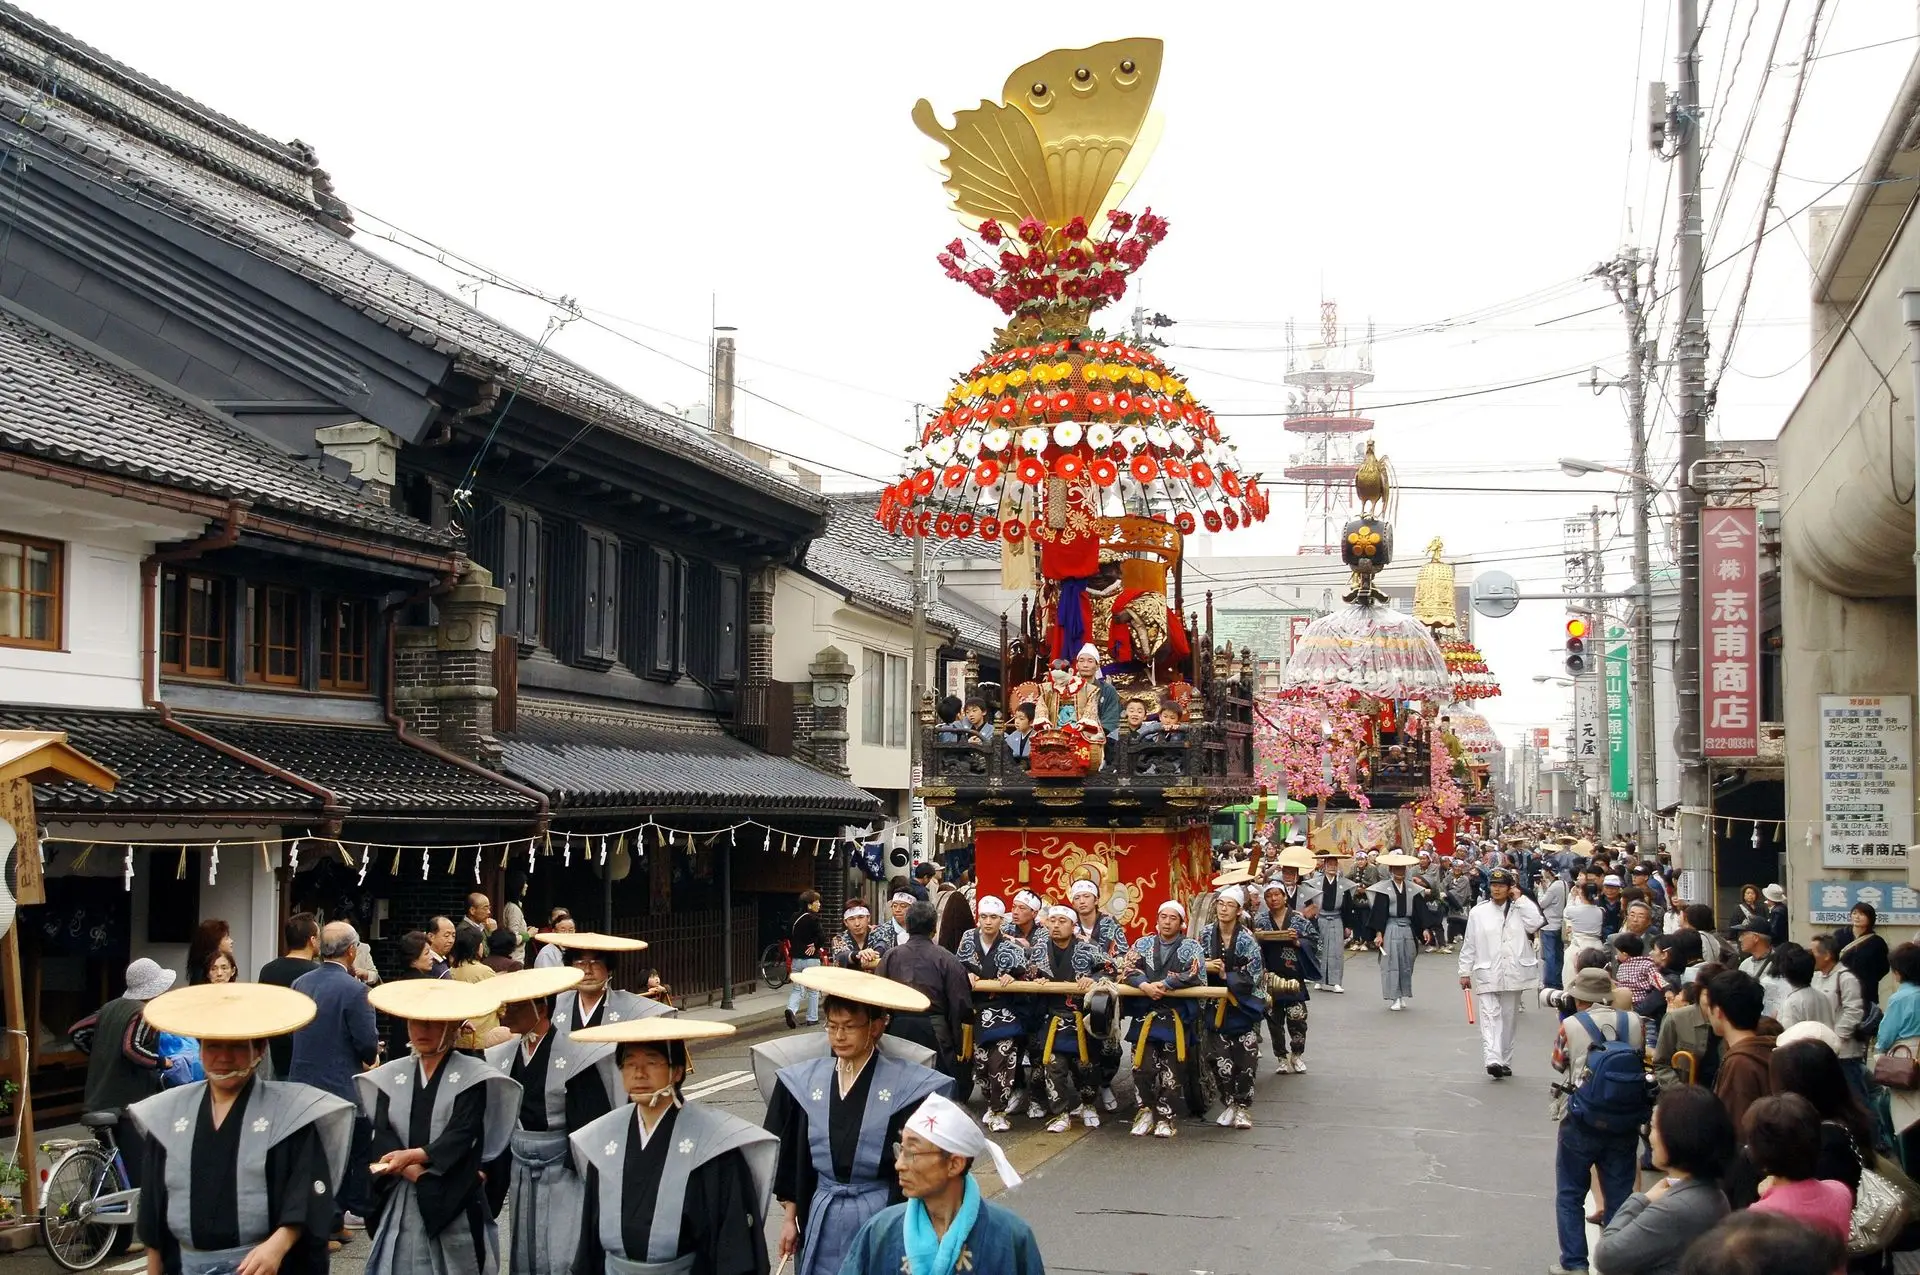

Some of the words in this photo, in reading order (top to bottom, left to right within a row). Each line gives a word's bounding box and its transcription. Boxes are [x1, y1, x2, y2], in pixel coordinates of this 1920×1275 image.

[1711, 588, 1749, 729] 志甫商店
[1605, 660, 1624, 752] 富山第一銀行
[1815, 912, 1889, 923] 高岡外院
[1821, 886, 1918, 909] 英会話
